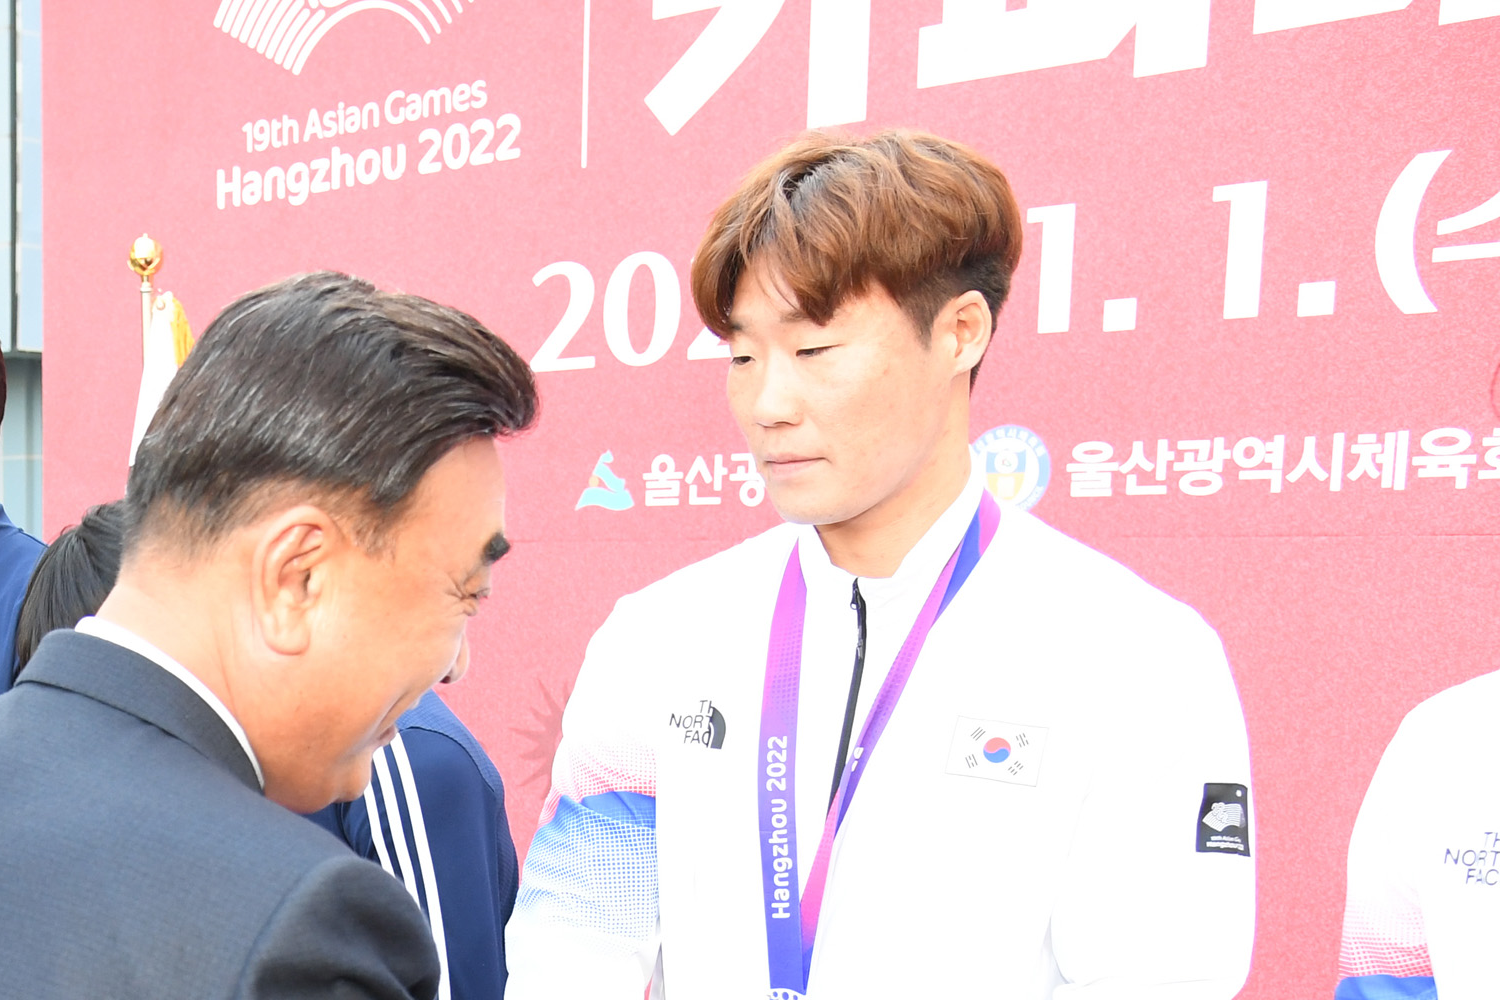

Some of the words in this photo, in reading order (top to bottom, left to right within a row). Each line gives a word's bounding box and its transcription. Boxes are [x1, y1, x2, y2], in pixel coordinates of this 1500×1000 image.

[242, 113, 299, 152] 19th
[304, 101, 379, 142] Asian
[384, 79, 487, 127] Games
[216, 142, 406, 210] Hangzhou
[417, 113, 521, 174] 2022
[765, 735, 788, 793] 2022
[769, 798, 793, 919] Hangzhou
